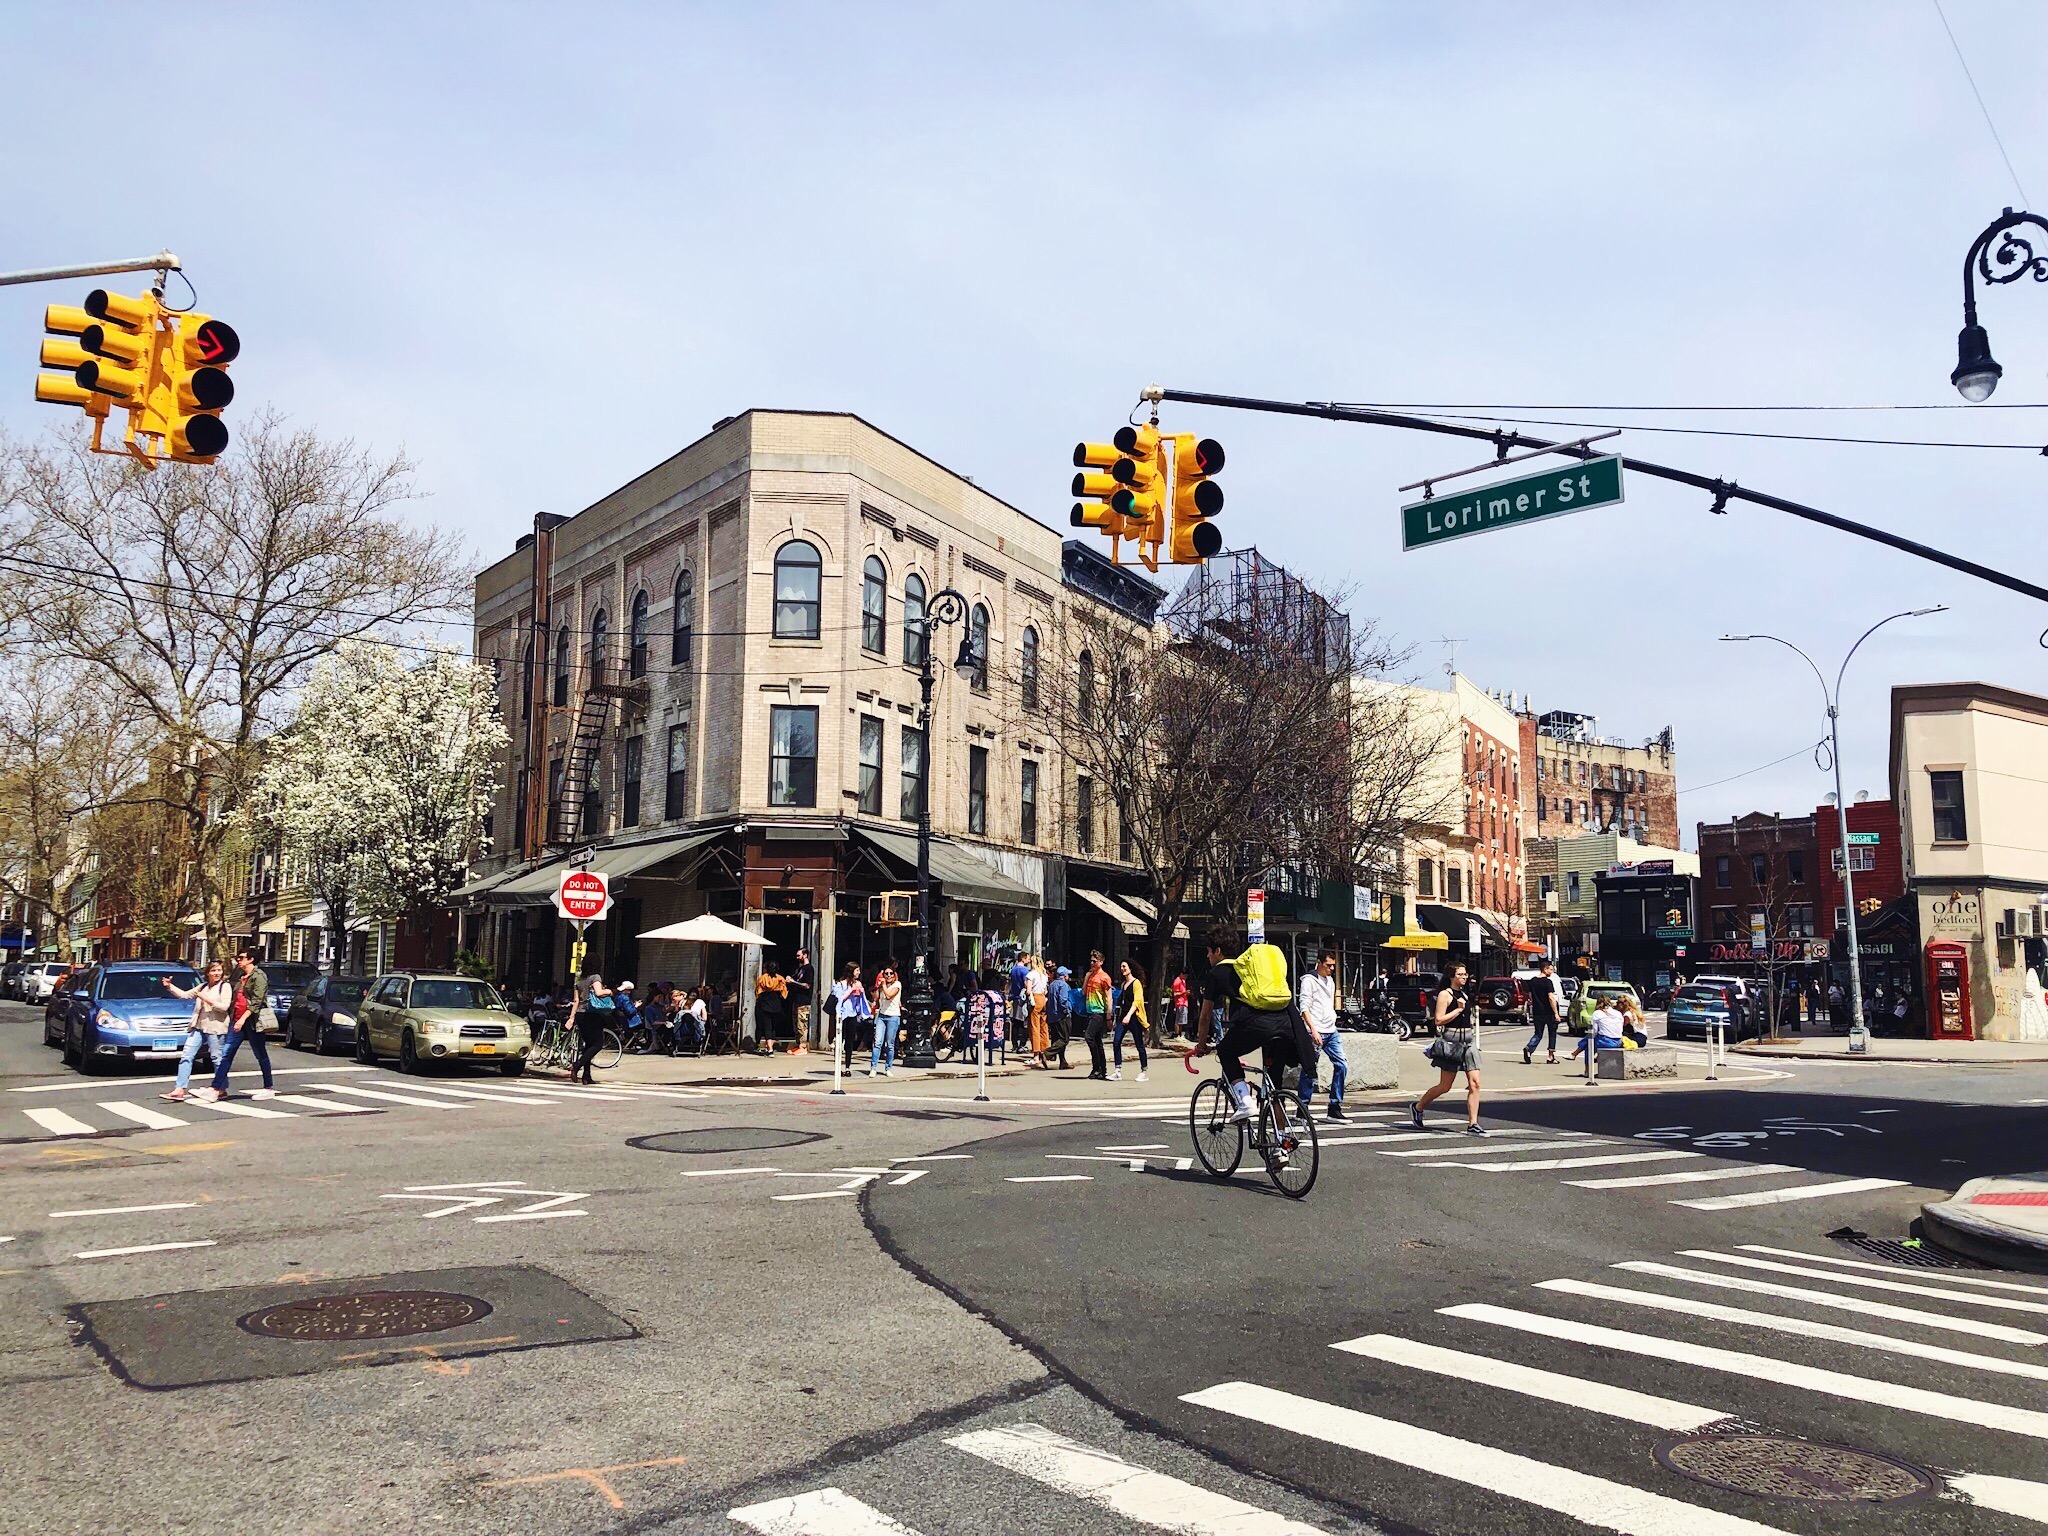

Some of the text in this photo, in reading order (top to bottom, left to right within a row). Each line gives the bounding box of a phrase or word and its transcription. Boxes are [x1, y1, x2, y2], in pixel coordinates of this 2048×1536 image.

[1426, 474, 1590, 534] Lorimer St
[1848, 834, 1871, 843] Nassau
[571, 854, 580, 863] ONE
[569, 880, 599, 890] DO NOT
[570, 900, 597, 910] ENTER
[1932, 901, 1977, 914] one
[1933, 914, 1978, 924] bedford
[1847, 943, 1894, 954] ASABI
